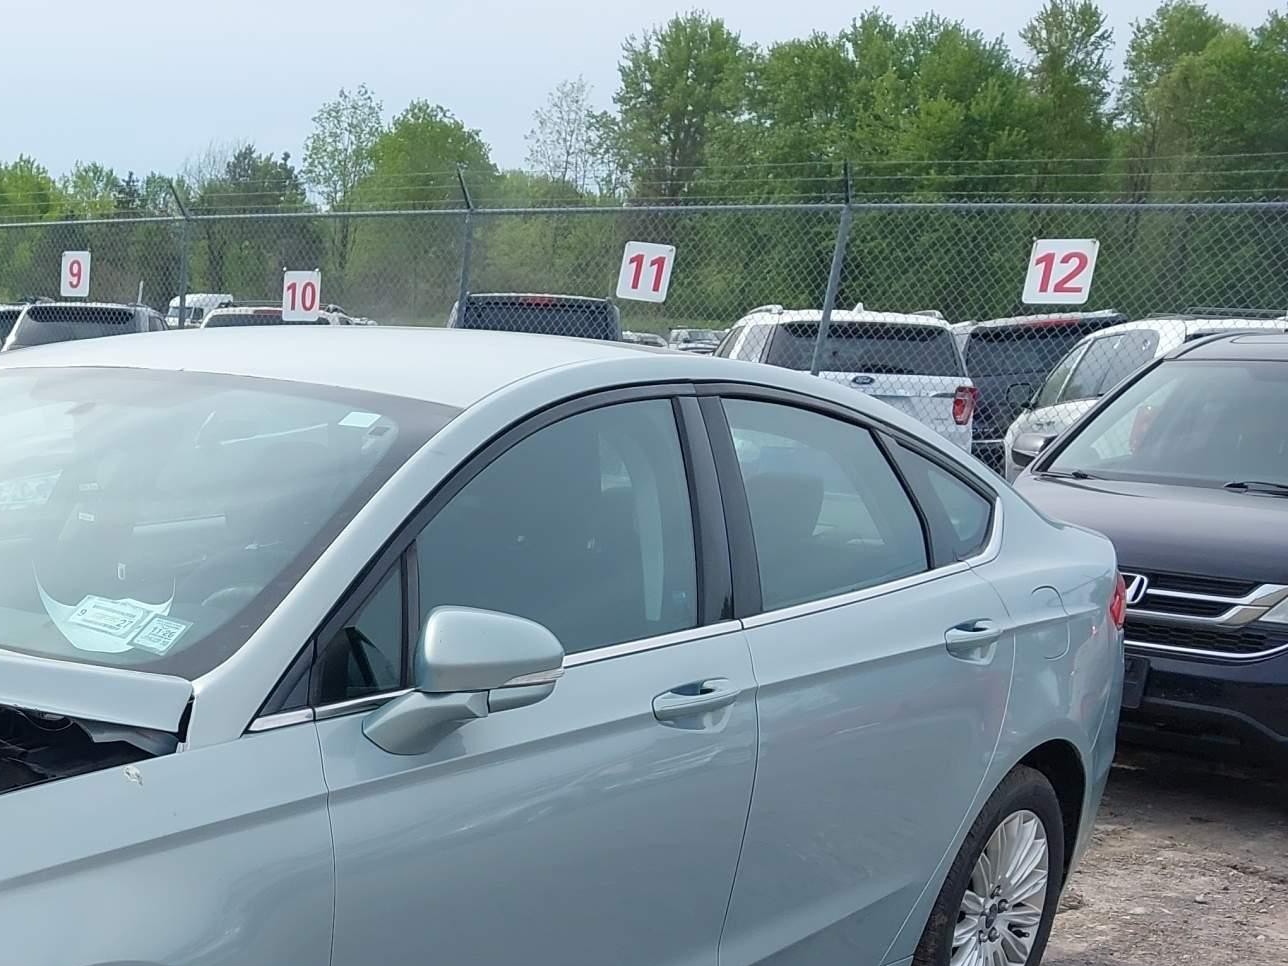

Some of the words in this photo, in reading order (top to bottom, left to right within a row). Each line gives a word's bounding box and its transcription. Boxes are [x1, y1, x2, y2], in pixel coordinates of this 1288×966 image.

[68, 259, 82, 289] 9
[628, 253, 667, 292] 11
[1034, 251, 1089, 293] 12
[286, 281, 316, 312] 10
